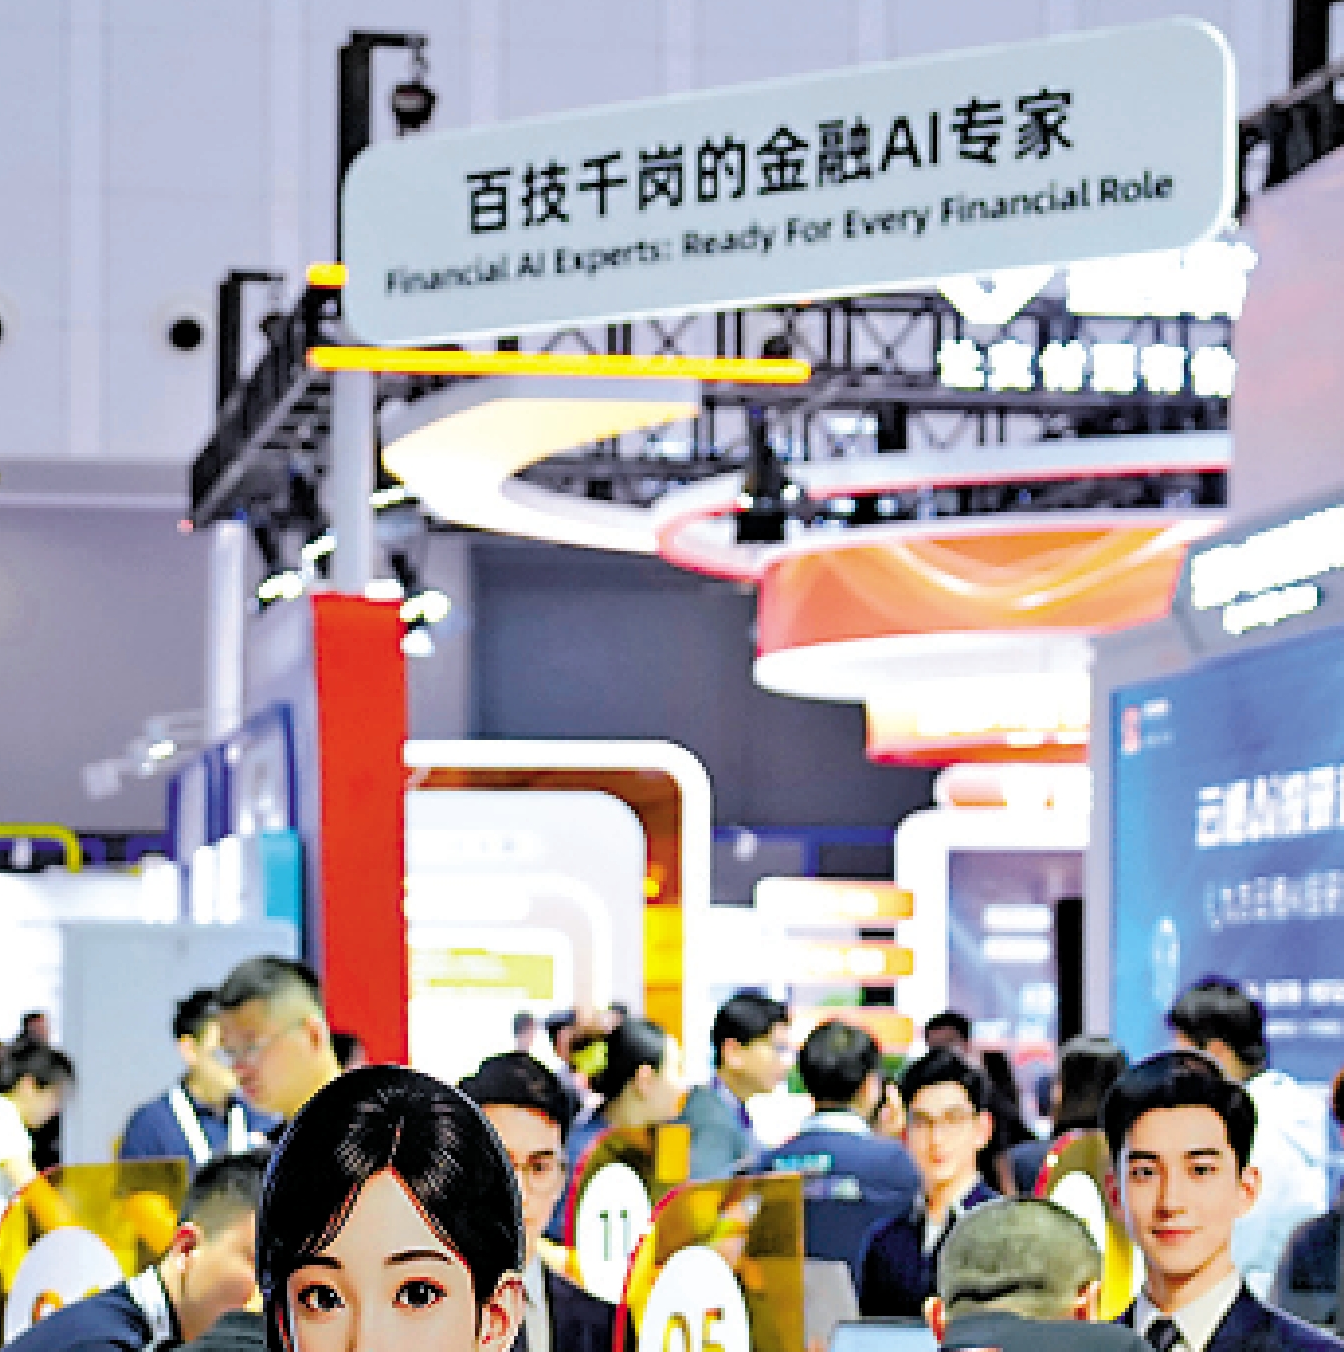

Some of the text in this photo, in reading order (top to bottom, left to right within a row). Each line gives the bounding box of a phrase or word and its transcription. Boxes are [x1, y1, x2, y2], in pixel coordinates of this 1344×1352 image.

[466, 87, 1073, 235] 百技千岗的金融AI专家
[385, 168, 1174, 296] Financial AI Experts: Ready For Every Financial Role
[595, 1208, 632, 1262] 11
